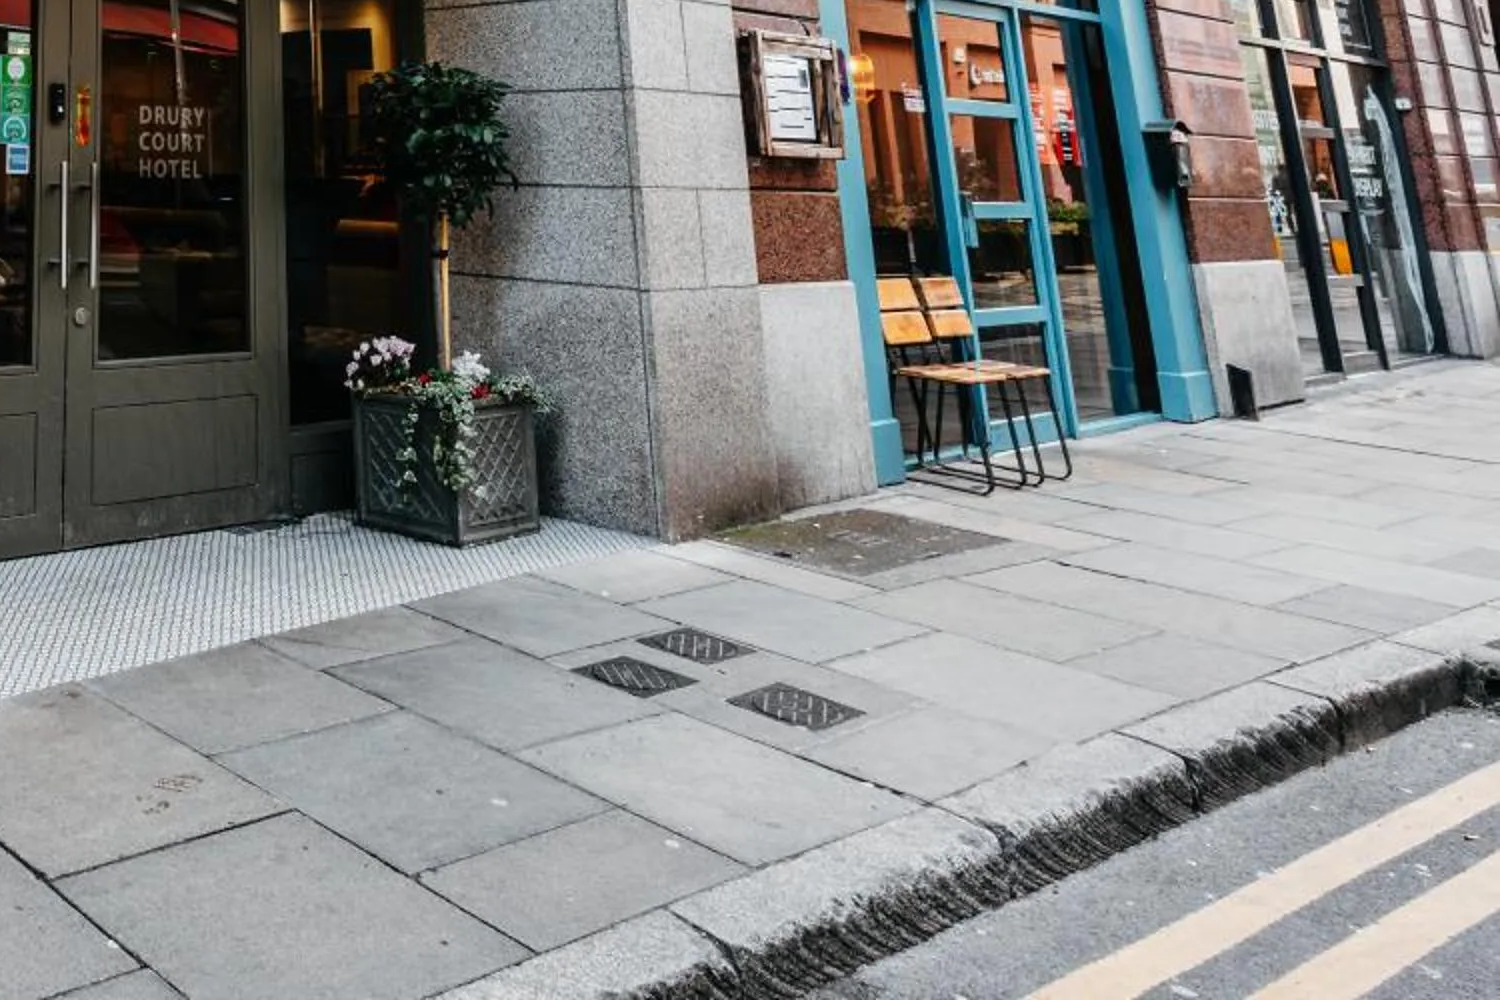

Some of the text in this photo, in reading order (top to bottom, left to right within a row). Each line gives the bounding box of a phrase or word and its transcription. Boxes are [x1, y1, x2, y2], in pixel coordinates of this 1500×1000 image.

[139, 104, 205, 128] DRURY
[139, 131, 206, 154] COURT
[139, 157, 203, 180] HOTEL
